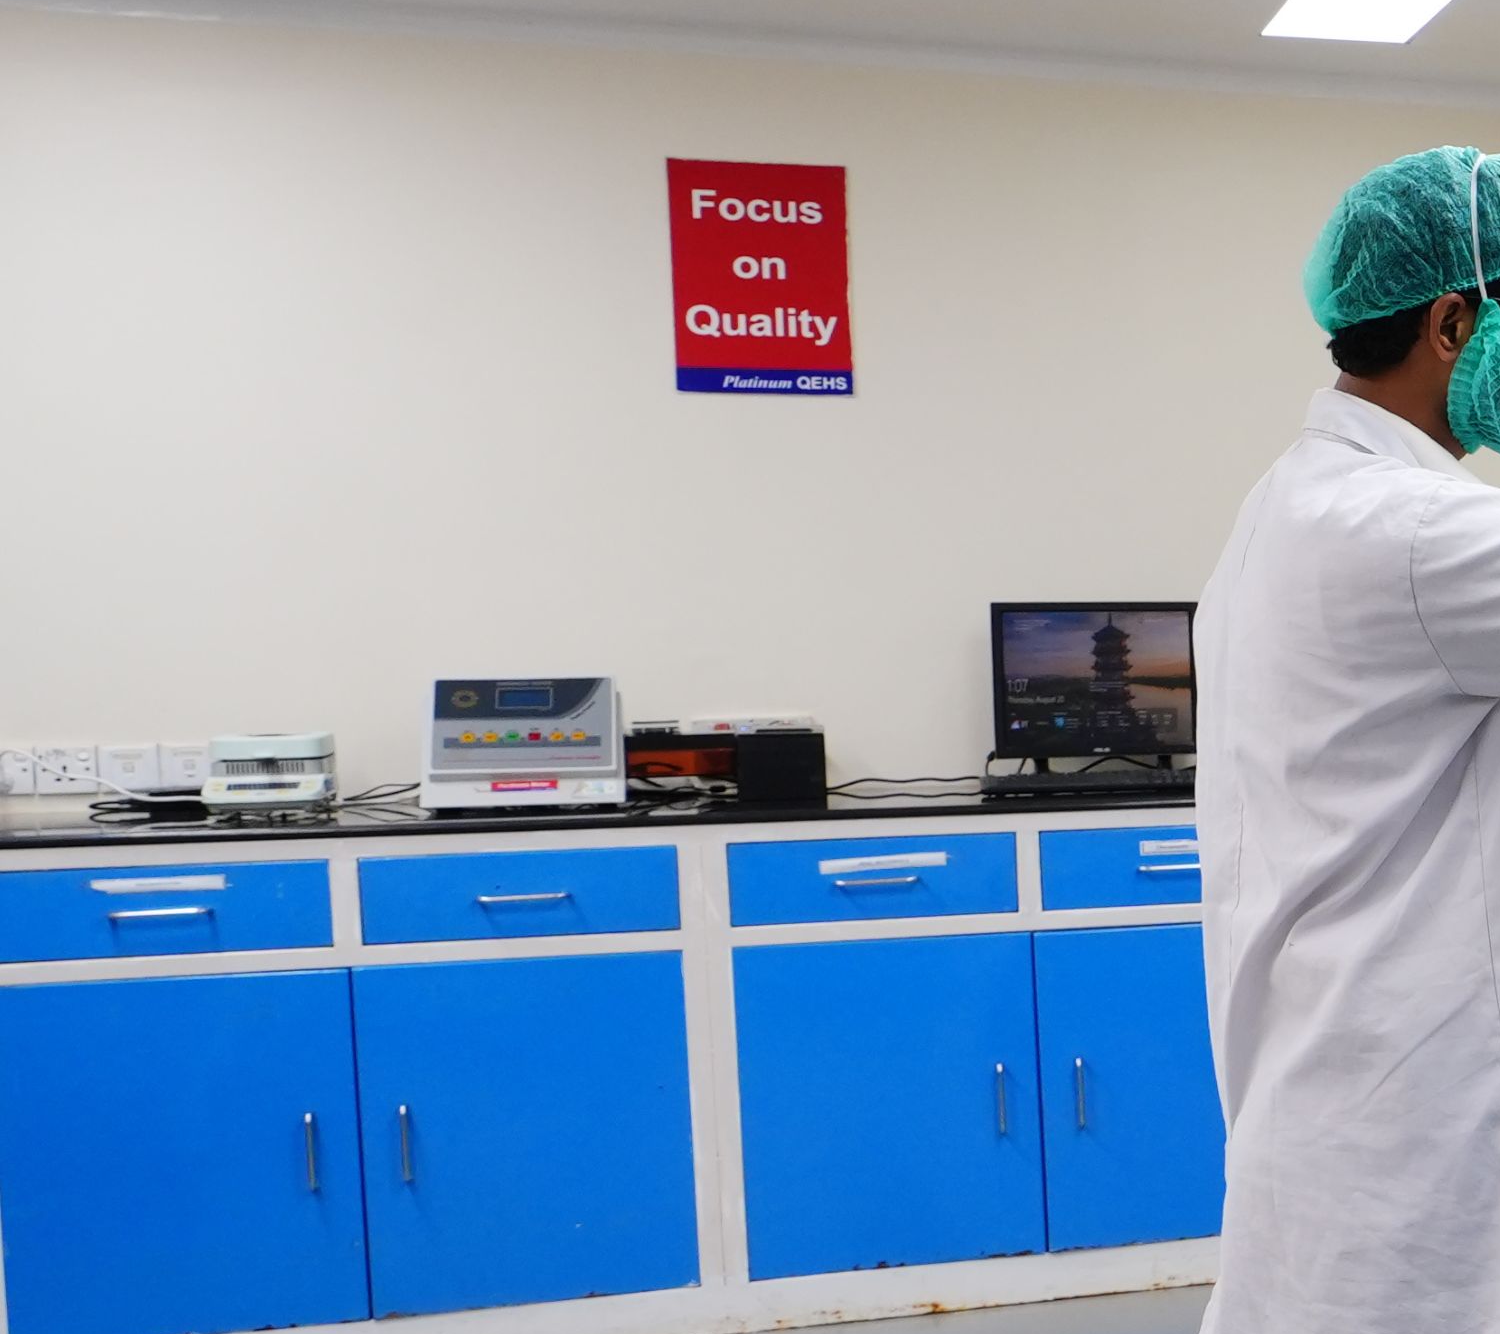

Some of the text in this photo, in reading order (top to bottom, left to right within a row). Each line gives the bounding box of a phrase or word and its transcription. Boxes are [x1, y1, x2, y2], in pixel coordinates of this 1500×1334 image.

[691, 188, 823, 225] Focus
[732, 255, 787, 280] on
[685, 304, 838, 347] Quality
[723, 375, 848, 390] Platinum QEHS
